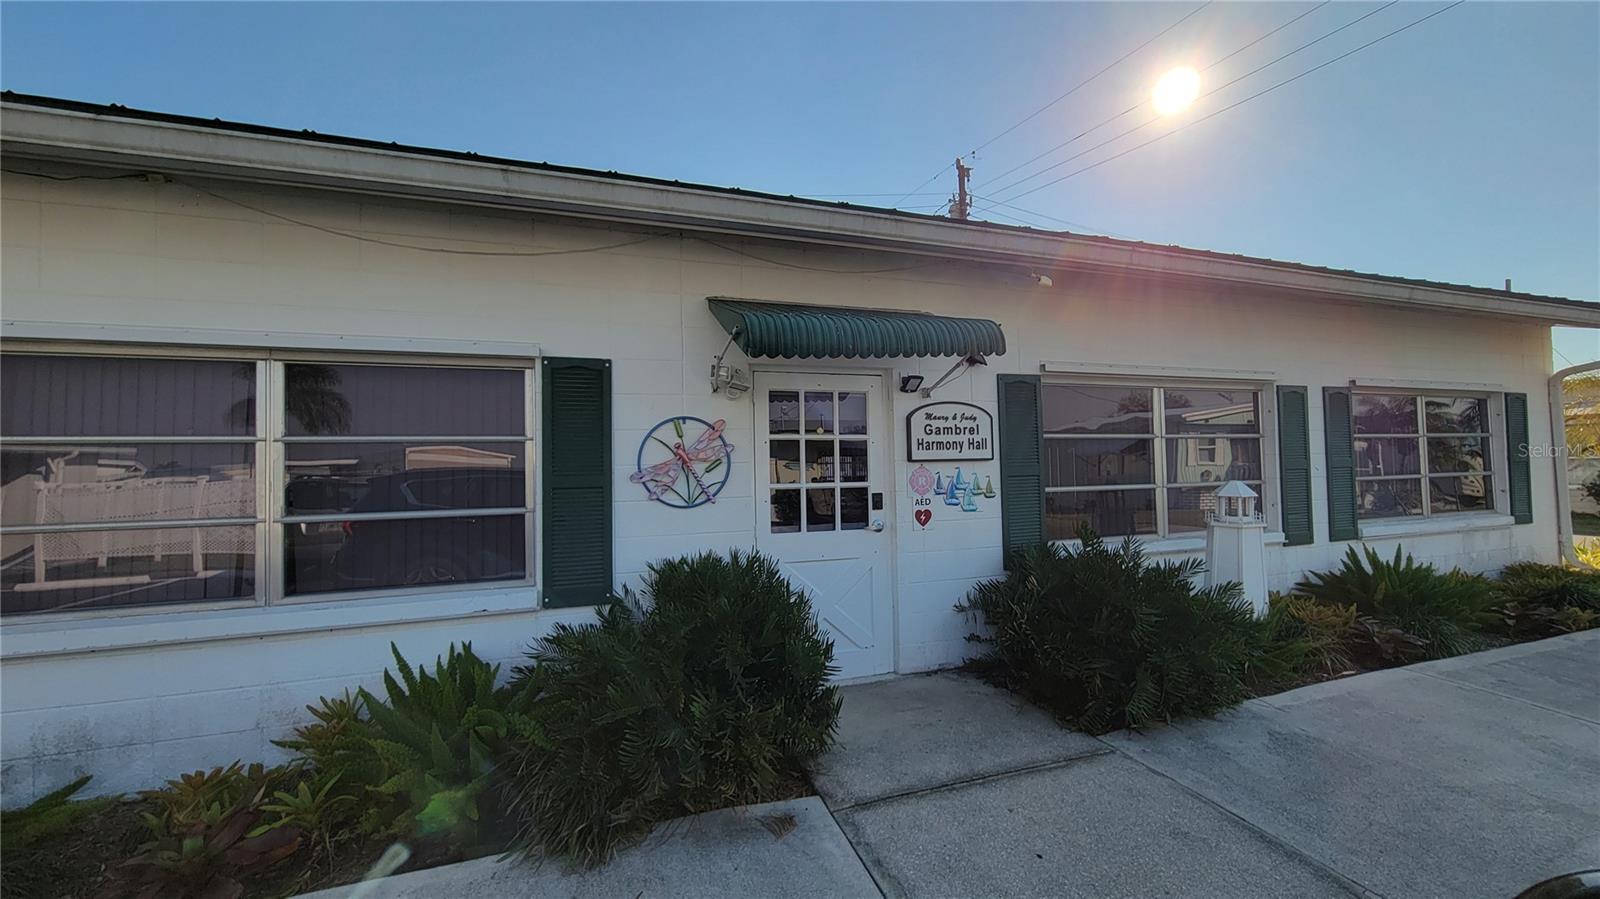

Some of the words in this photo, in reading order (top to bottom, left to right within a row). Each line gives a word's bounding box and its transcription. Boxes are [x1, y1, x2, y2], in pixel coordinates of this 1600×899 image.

[924, 412, 949, 422] Maury
[952, 413, 958, 421] &
[960, 412, 977, 423] Judy
[924, 423, 979, 436] Gambrel
[917, 438, 964, 453] Harmony
[968, 437, 987, 450] Hall
[915, 498, 931, 506] AED
